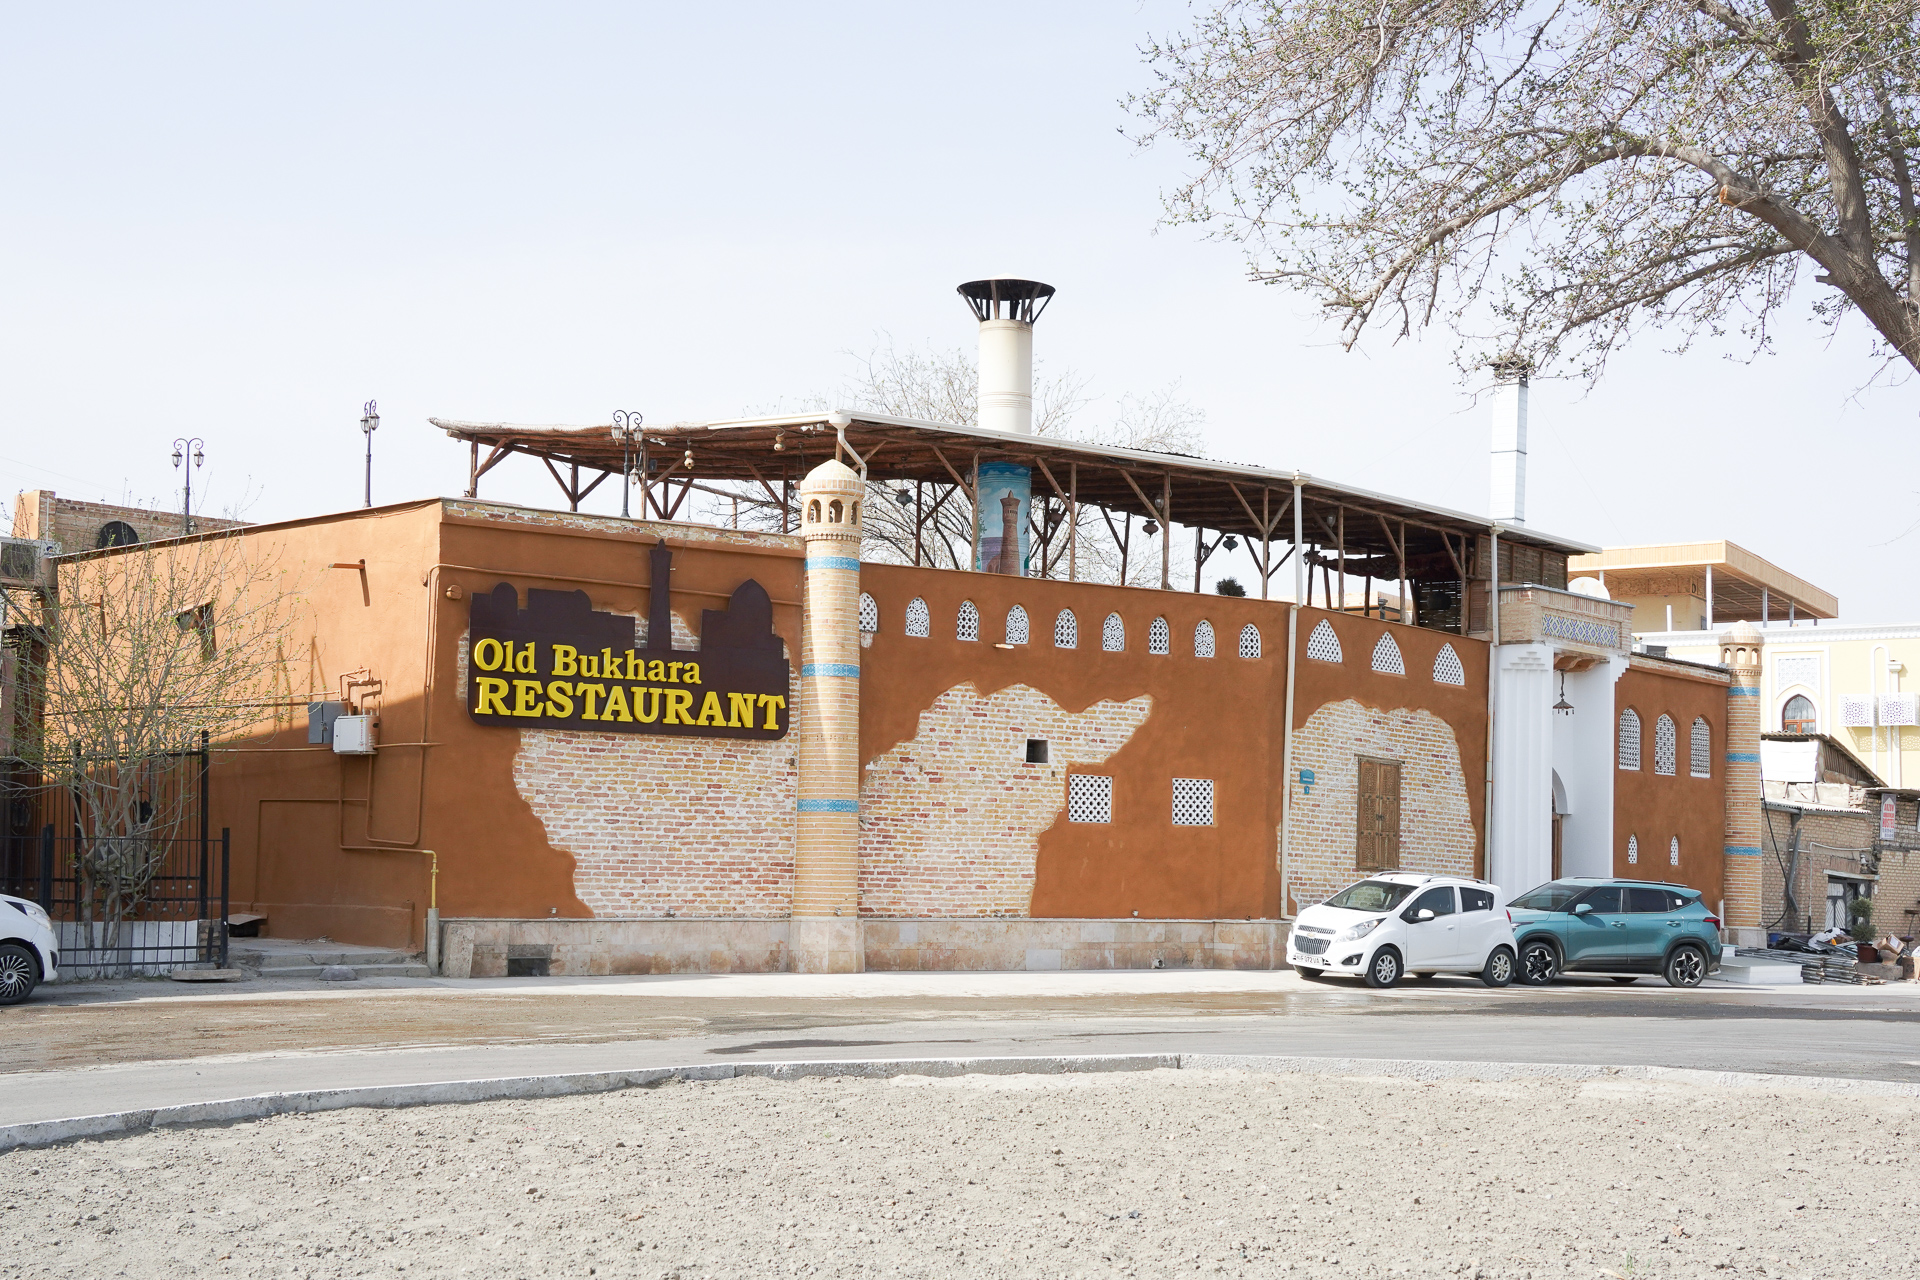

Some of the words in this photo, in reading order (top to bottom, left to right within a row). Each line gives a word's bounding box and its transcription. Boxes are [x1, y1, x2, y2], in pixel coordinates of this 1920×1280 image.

[474, 638, 537, 674] Old
[551, 644, 702, 685] Bukhara
[474, 676, 786, 730] RESTAURANT
